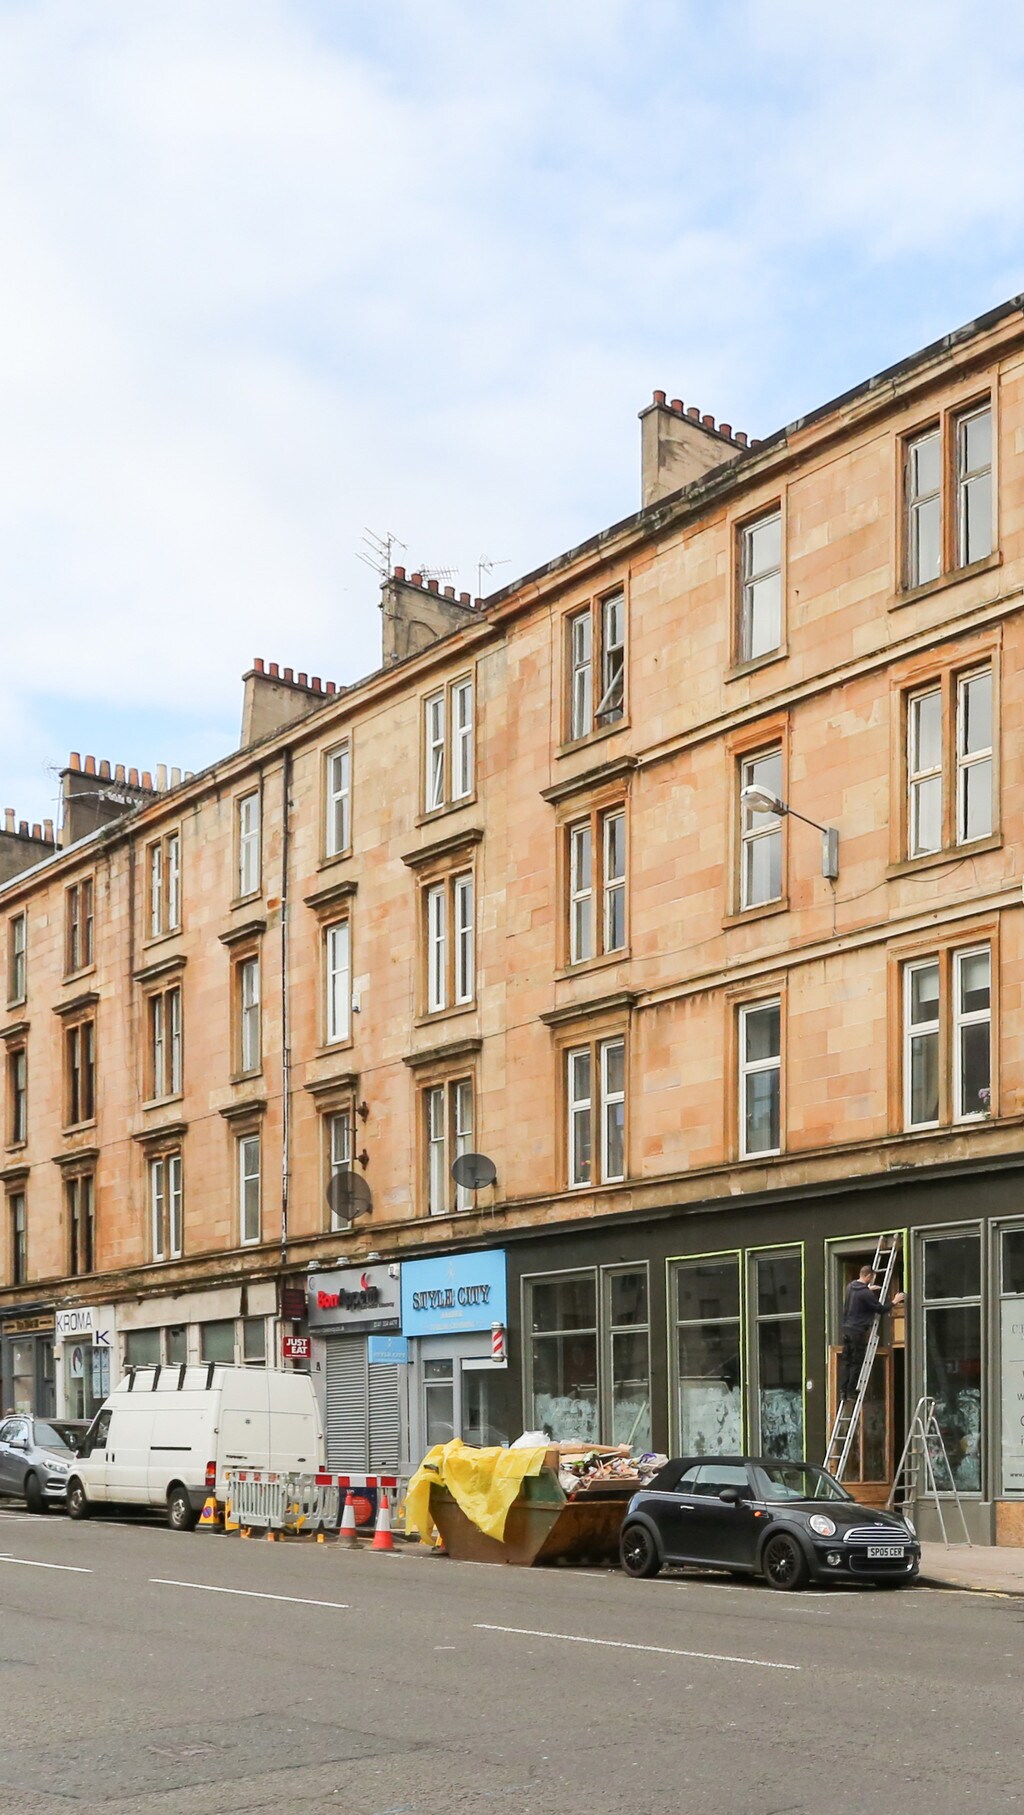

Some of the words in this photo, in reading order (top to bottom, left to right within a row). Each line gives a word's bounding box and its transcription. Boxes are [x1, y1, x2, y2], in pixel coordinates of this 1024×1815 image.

[317, 1290, 340, 1309] Bon
[412, 1288, 455, 1311] STYLE
[458, 1284, 491, 1306] CITY
[56, 1312, 92, 1332] KROMA
[96, 1330, 110, 1345] K
[291, 1346, 308, 1354] EAT
[870, 1548, 889, 1556] SP05
[890, 1548, 902, 1556] CER
